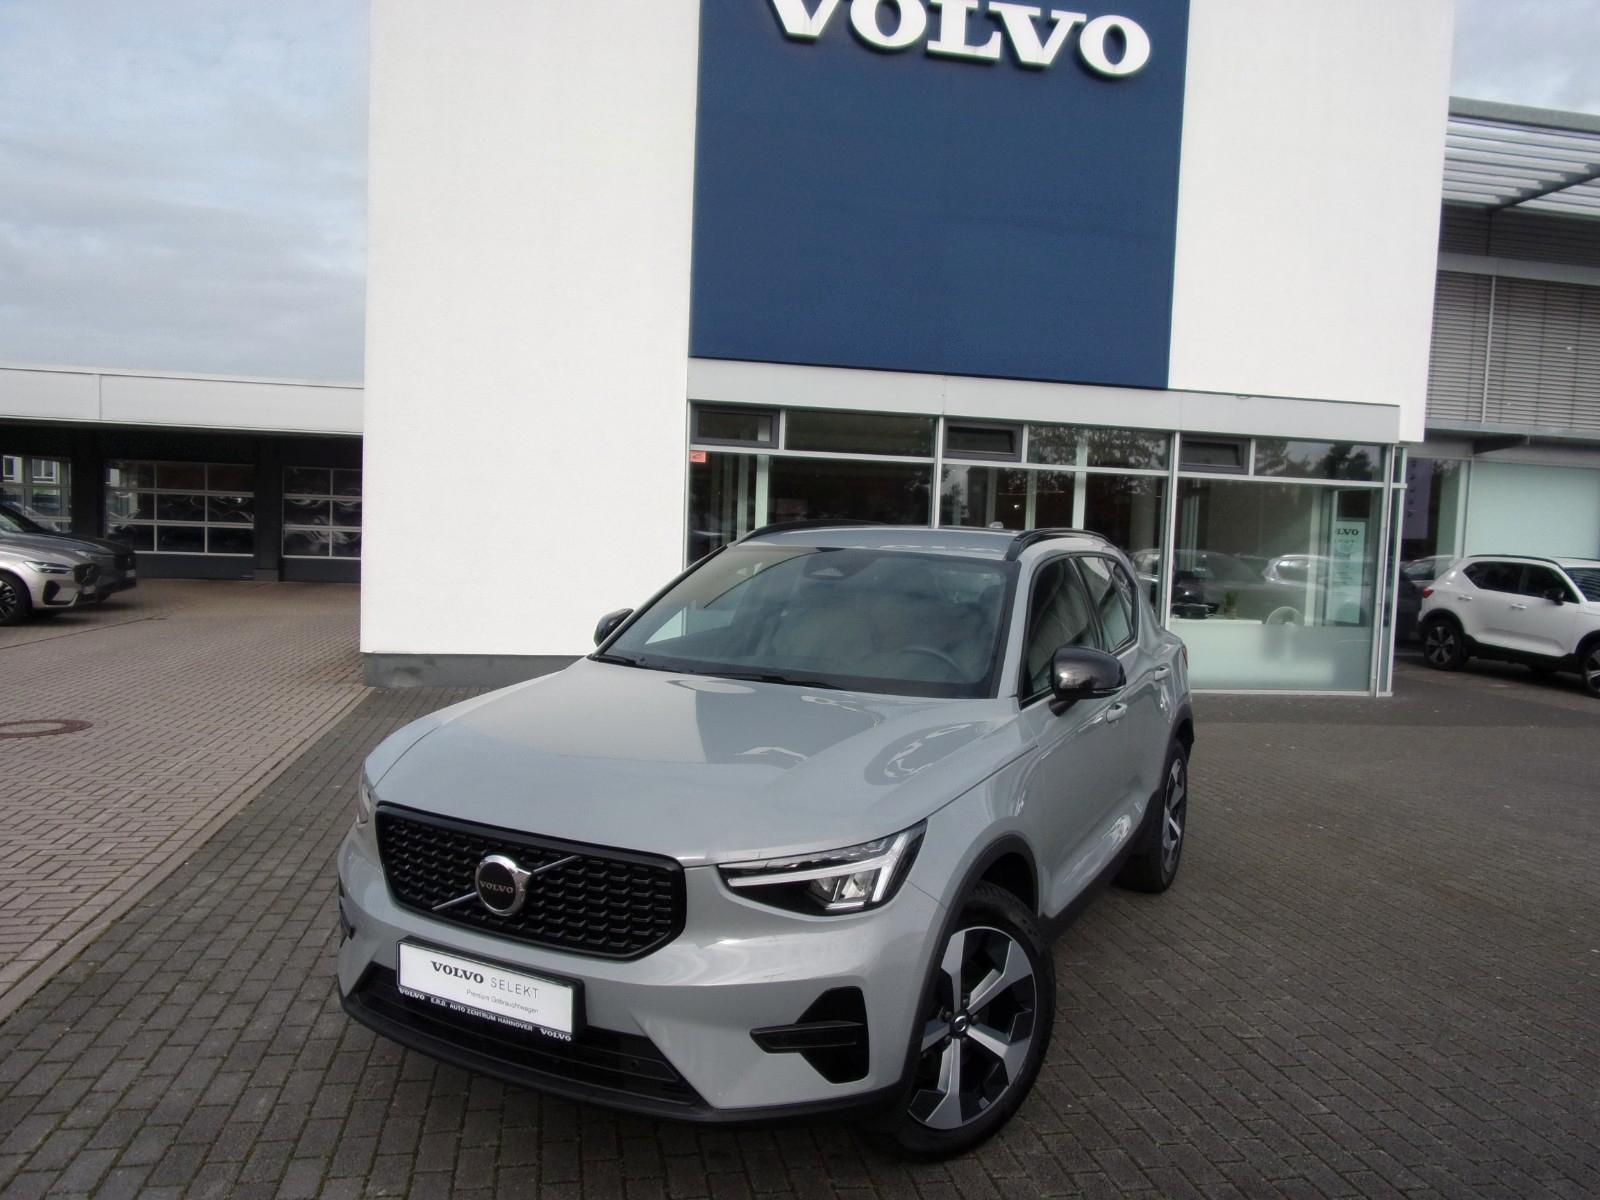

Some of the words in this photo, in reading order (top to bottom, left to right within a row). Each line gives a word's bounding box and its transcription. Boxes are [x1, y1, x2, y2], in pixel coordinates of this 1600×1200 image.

[769, 0, 1151, 76] VOLVO
[1334, 528, 1359, 536] LVO
[480, 880, 514, 894] VOLVO
[430, 960, 484, 984] VOLVO
[490, 977, 539, 999] SELEKT
[398, 986, 425, 1000] VOLVO
[449, 1003, 466, 1013] AUTO
[466, 1008, 496, 1021] ZENTRUM
[497, 1016, 533, 1031] HANNOVER
[539, 1028, 572, 1042] VOLVO
[491, 996, 539, 1013] Gebrauchtwagen
